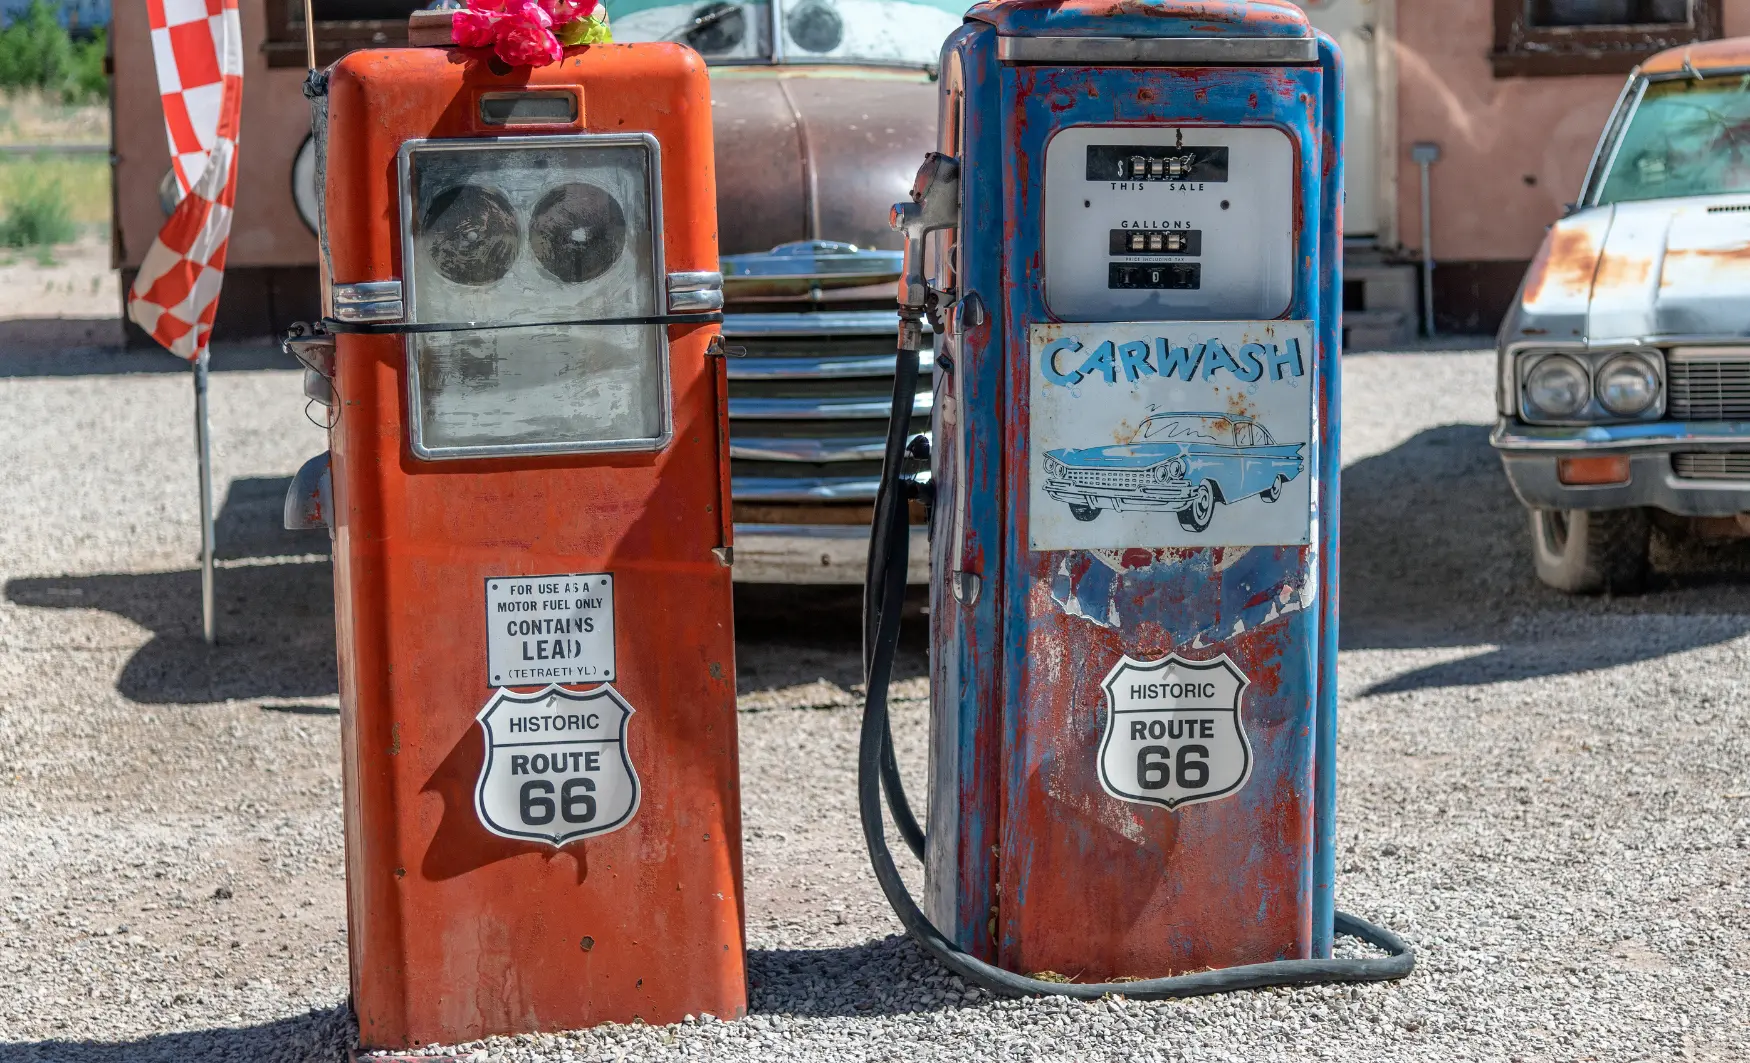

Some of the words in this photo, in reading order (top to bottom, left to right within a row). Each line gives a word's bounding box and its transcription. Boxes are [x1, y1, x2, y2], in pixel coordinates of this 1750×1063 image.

[1111, 182, 1144, 191] THIS
[1169, 183, 1204, 191] SALE
[1121, 220, 1191, 229] GALLONS
[1040, 336, 1304, 387] CARWASH
[510, 584, 532, 596] FOR
[538, 583, 560, 594] USE
[565, 582, 579, 593] AS
[582, 582, 590, 593] A
[497, 601, 537, 613] MOTOR
[543, 599, 571, 611] FUEL
[575, 598, 603, 610] ONLY
[507, 617, 594, 637] CONTAINS
[1130, 682, 1215, 700] HISTORIC
[509, 713, 600, 733] HISTORIC
[1130, 719, 1215, 741] ROUTE
[511, 751, 601, 775] ROUTE
[1136, 744, 1209, 790] 66
[519, 777, 597, 826] 66
